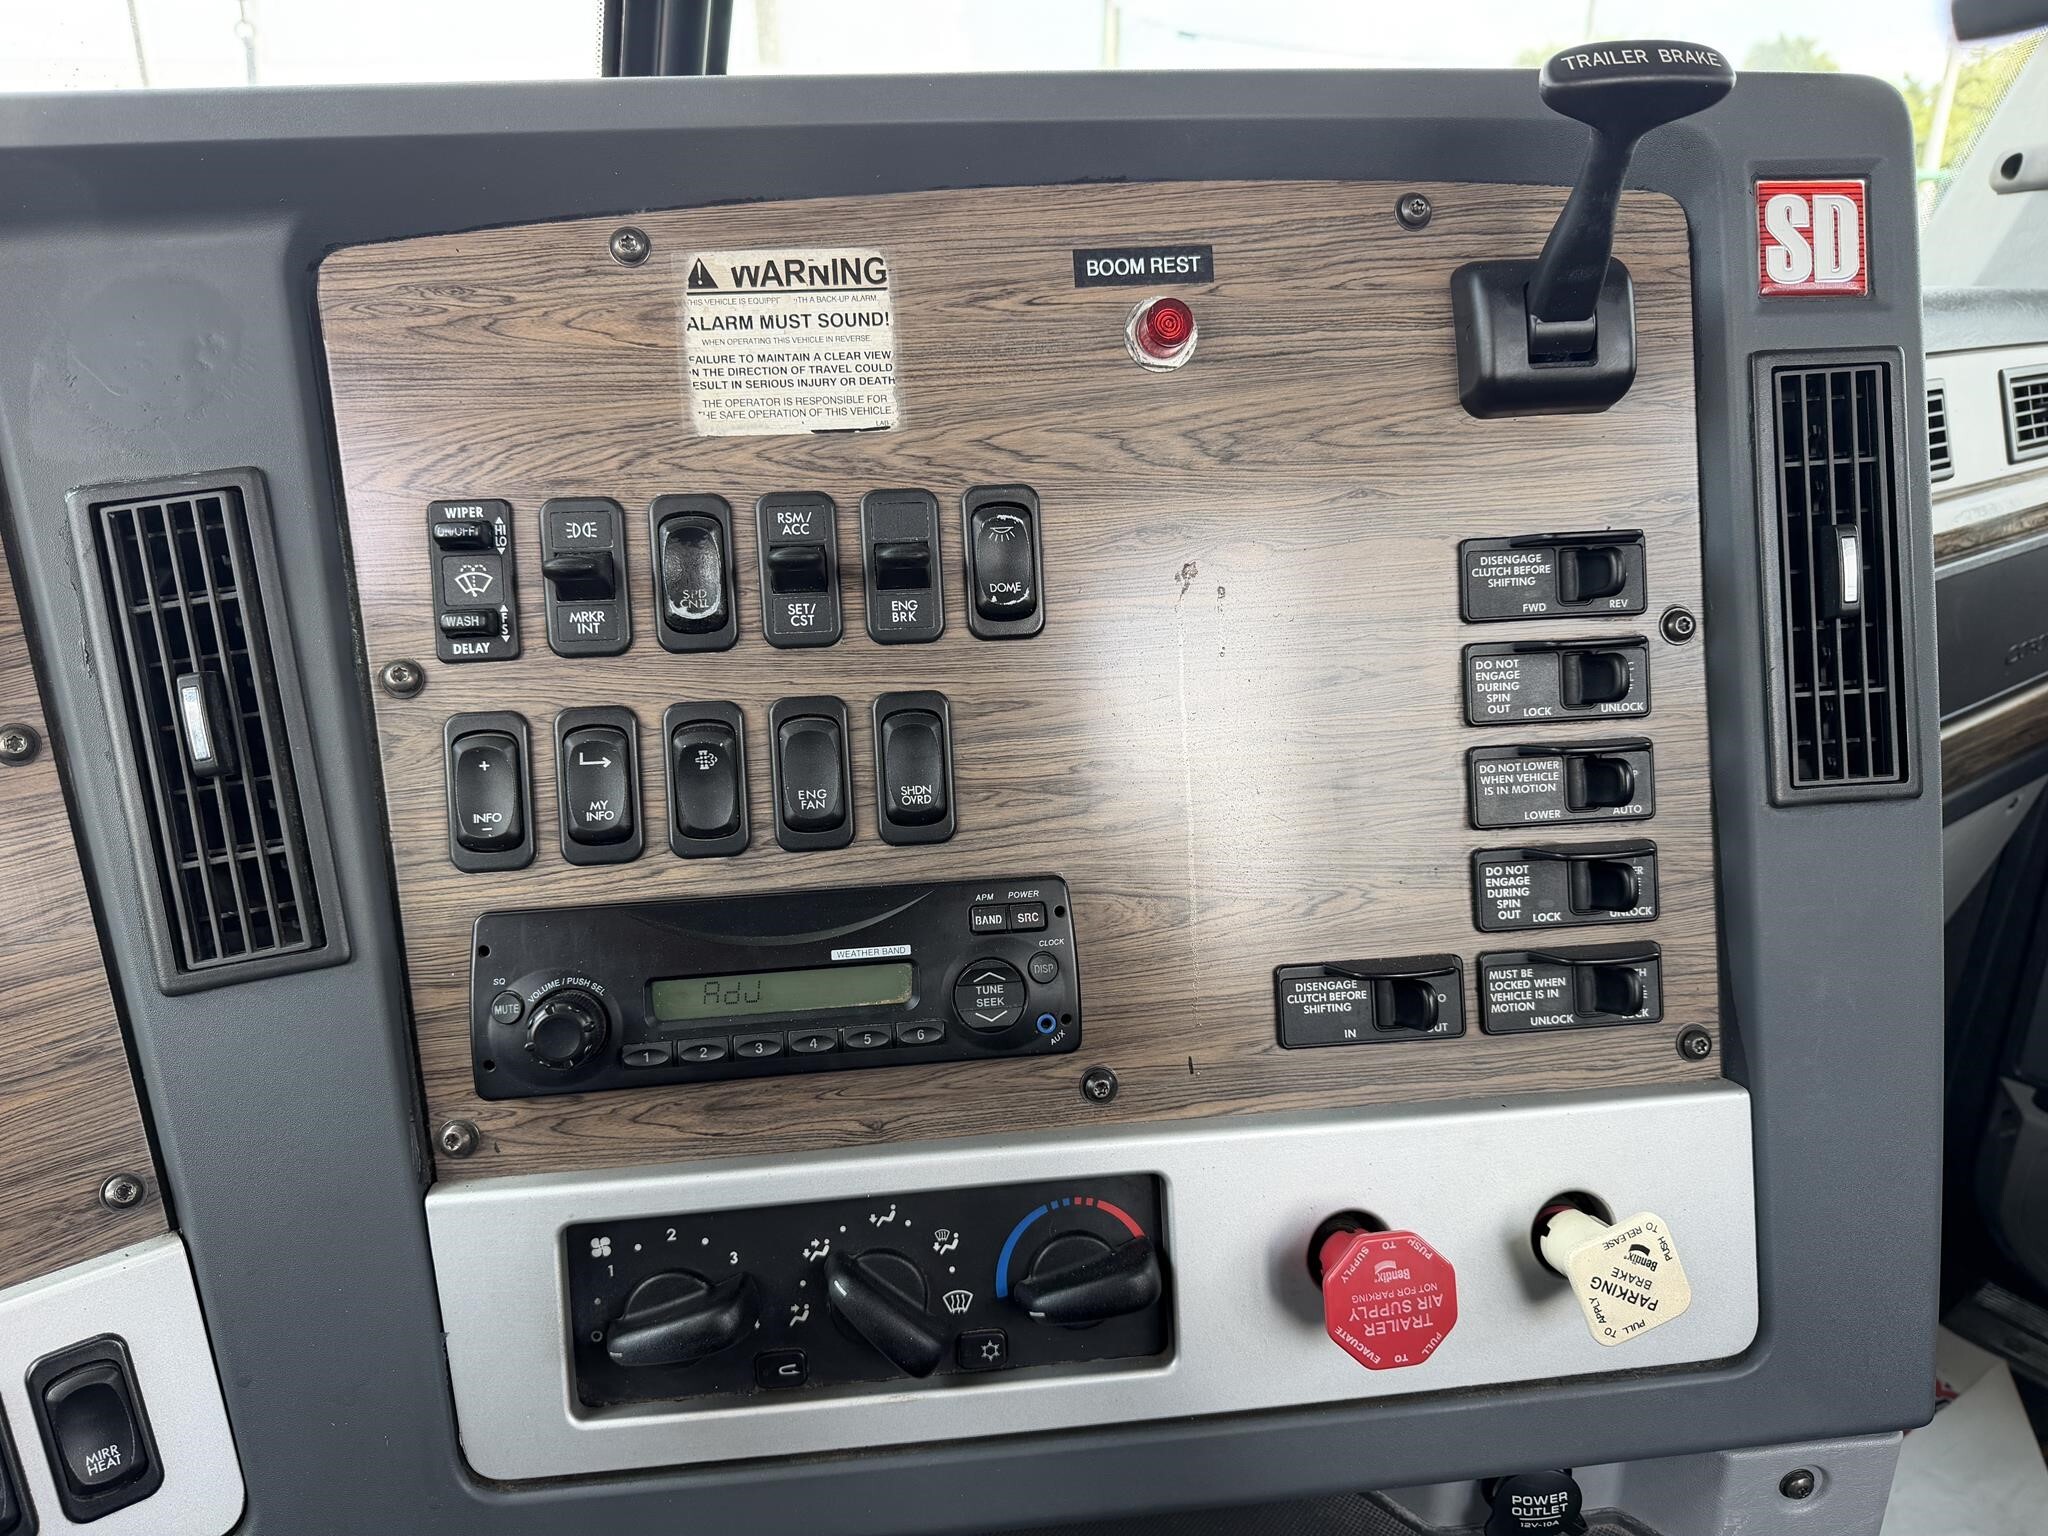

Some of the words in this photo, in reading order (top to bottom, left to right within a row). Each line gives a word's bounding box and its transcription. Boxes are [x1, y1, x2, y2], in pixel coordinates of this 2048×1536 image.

[1562, 50, 1649, 70] TRAILER
[1658, 49, 1722, 67] BRAKE
[1765, 194, 1860, 283] SD
[1087, 257, 1144, 276] BOOM
[1151, 256, 1200, 274] REST
[731, 257, 887, 288] WARNING
[687, 315, 753, 331] ALARM
[760, 314, 812, 330] MUST
[818, 312, 889, 328] SOUND!
[792, 336, 824, 344] VEHICLE
[689, 355, 736, 364] FAILURE
[739, 354, 754, 363] TO
[757, 353, 810, 362] MAINTAIN
[814, 353, 821, 361] A
[824, 352, 861, 360] CLEAR
[864, 351, 891, 359] VIEW
[703, 368, 724, 376] THE
[728, 367, 787, 376] DIRECTION
[791, 366, 806, 374] OF
[809, 365, 852, 374] TRAVEL
[855, 364, 893, 372] COULD
[732, 381, 742, 389] IN
[746, 380, 794, 389] SERIOUS
[798, 378, 837, 387] INJURY
[841, 377, 856, 386] OR
[860, 377, 896, 385] DEATH
[703, 400, 722, 408] THE
[725, 398, 780, 407] OPERATOR
[784, 397, 793, 405] IS
[796, 395, 864, 405] RESPONSIBLE
[867, 395, 888, 403] FOR
[720, 411, 745, 419] SAFE
[748, 409, 806, 418] OPERATION
[809, 408, 822, 417] OF
[825, 407, 848, 416] THIS
[850, 406, 895, 415] VEHICLE.
[445, 507, 483, 519] WIPER
[777, 511, 812, 524] RSM/
[495, 525, 506, 535] HI
[782, 523, 810, 535] ACC
[496, 536, 507, 547] LO
[1480, 554, 1542, 566] DISENGAGE
[1472, 566, 1511, 577] CLUTCH
[1514, 564, 1551, 575] BEFORE
[989, 582, 1022, 594] DOME
[1488, 577, 1536, 588] SHIFTING
[788, 603, 816, 616] SET/
[891, 600, 918, 611] ENG
[1522, 603, 1546, 613] FWD
[1609, 599, 1628, 609] REV
[446, 616, 480, 627] WASH
[569, 611, 605, 624] MRKR
[791, 615, 815, 627] CST
[892, 611, 917, 622] BRK
[578, 623, 600, 634] INT
[453, 642, 490, 655] DELAY
[1475, 661, 1492, 670] DO
[1495, 659, 1519, 669] NOT
[1475, 671, 1520, 681] ENGAGE
[1477, 682, 1520, 692] DURING
[1487, 694, 1510, 703] SPIN
[1488, 704, 1511, 714] OUT
[1523, 707, 1552, 717] LOCK
[1601, 702, 1644, 713] UNLOCK
[1479, 764, 1495, 774] DO
[1498, 763, 1522, 772] NOT
[1523, 761, 1559, 771] LOWER
[1480, 774, 1514, 784] WHEN
[1516, 772, 1559, 782] VEHICLE
[798, 789, 827, 800] ENG
[901, 785, 932, 796] SHDN
[1484, 786, 1493, 796] IS
[1497, 786, 1508, 795] IN
[1512, 784, 1556, 794] MOTION
[590, 800, 609, 811] MY
[801, 800, 825, 810] FAN
[901, 795, 932, 805] OVRD
[1524, 810, 1561, 820] LOWER
[1613, 805, 1642, 814] AUTO
[473, 813, 502, 823] INFO
[586, 811, 615, 822] INFO
[1485, 867, 1502, 876] DO
[1505, 865, 1529, 875] NOT
[1485, 876, 1531, 887] ENGAGE
[975, 893, 994, 901] APM
[1008, 890, 1040, 899] POWER
[1487, 888, 1530, 898] DURING
[1497, 899, 1521, 909] SPIN
[975, 915, 1002, 926] BAND
[1017, 912, 1039, 923] SRC
[1498, 910, 1521, 920] OUT
[1533, 912, 1562, 923] LOCK
[1039, 938, 1065, 947] CLOCK
[837, 948, 880, 959] WEATHER
[881, 946, 906, 956] BAND
[1034, 964, 1054, 974] DISP
[1489, 970, 1517, 980] MUST
[1521, 969, 1533, 978] BE
[528, 979, 560, 1002] VOLUME
[567, 977, 591, 987] PUSH
[591, 982, 606, 996] SEL
[976, 985, 1004, 995] TUNE
[1296, 980, 1357, 992] DISENGAGE
[1490, 980, 1530, 991] LOCKED
[1533, 977, 1566, 987] WHEN
[976, 996, 1005, 1007] SEEK
[1287, 993, 1327, 1004] CLUTCH
[1329, 991, 1367, 1002] BEFORE
[1490, 991, 1533, 1002] VEHICLE
[1535, 990, 1544, 999] IS
[1547, 989, 1559, 998] IN
[494, 1004, 519, 1015] MUTE
[1303, 1003, 1352, 1014] SHIFTING
[1491, 1002, 1535, 1013] MOTION
[1530, 1014, 1574, 1026] UNLOCK
[1050, 1029, 1066, 1046] AUX
[1344, 1029, 1357, 1038] IN
[1645, 1222, 1658, 1233] TO
[1602, 1226, 1642, 1251] RELEASE
[1382, 1241, 1397, 1250] TO
[1407, 1239, 1433, 1260] PUSH
[1657, 1237, 1672, 1261] PUSH
[729, 1251, 739, 1265] 3
[1341, 1246, 1369, 1284] SUPPLY
[1611, 1267, 1653, 1290] BRAKE
[1397, 1287, 1416, 1296] FOR
[1419, 1283, 1438, 1293] NOT
[1590, 1276, 1658, 1311] PARKING
[1352, 1291, 1394, 1303] PARKING
[1417, 1294, 1443, 1309] AIR
[1349, 1300, 1412, 1321] SUPPLY
[1589, 1297, 1607, 1323] APPLY
[1363, 1313, 1434, 1337] TRAILER
[1622, 1319, 1646, 1334] PULL
[1604, 1327, 1617, 1338] TO
[1334, 1326, 1381, 1364] EVACUATE
[1421, 1331, 1442, 1355] PULL
[1394, 1354, 1408, 1362] TO
[85, 1444, 118, 1466] MIRR
[87, 1453, 121, 1476] HEAT
[1512, 1491, 1568, 1505] POWER
[1512, 1503, 1569, 1516] OUTLET
[1520, 1520, 1560, 1528] 12V-10A
